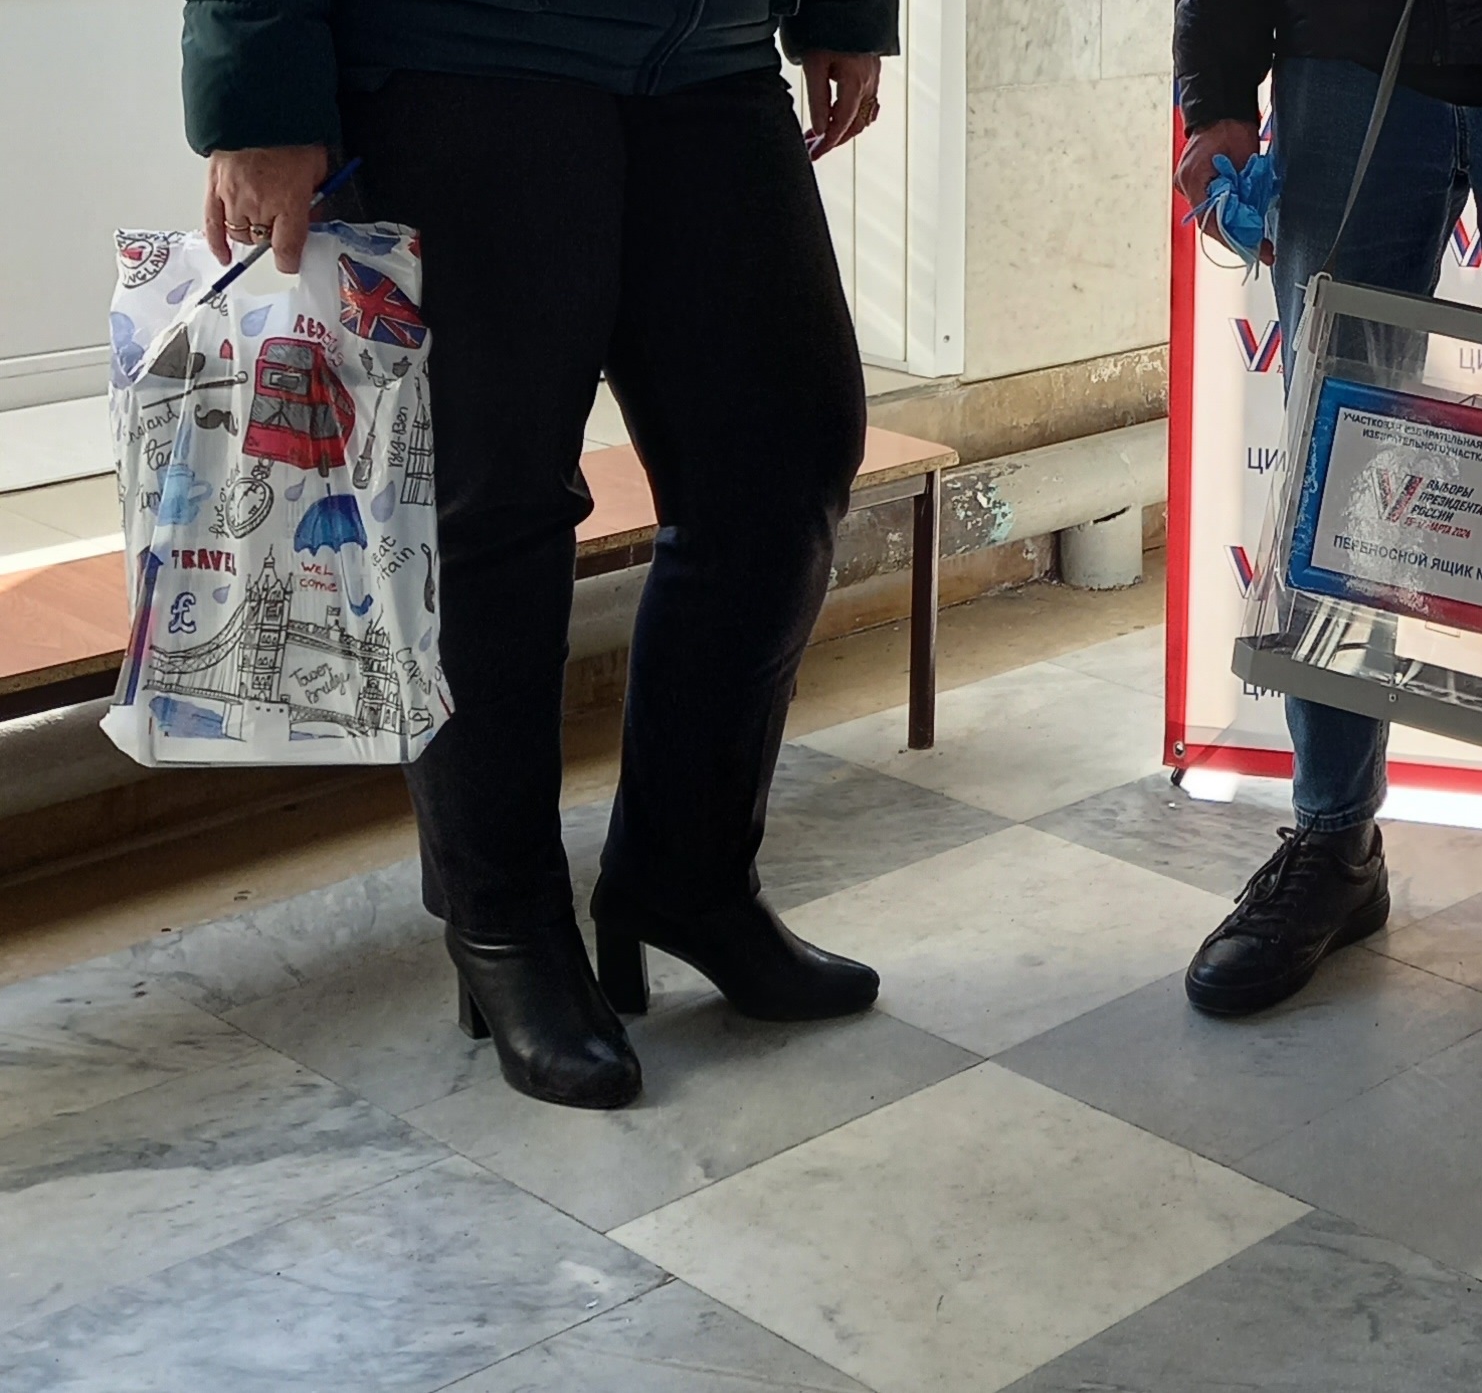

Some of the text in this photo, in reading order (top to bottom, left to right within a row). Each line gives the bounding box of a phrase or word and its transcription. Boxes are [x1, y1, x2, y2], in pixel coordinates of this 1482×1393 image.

[1426, 479, 1475, 498] ВЫБОРЫ
[1410, 505, 1455, 523] РОССИИ
[171, 548, 237, 576] TRAVEL
[1333, 535, 1428, 568] ПЕРЕНОСНОЙ
[1431, 558, 1473, 579] ЯЩИК
